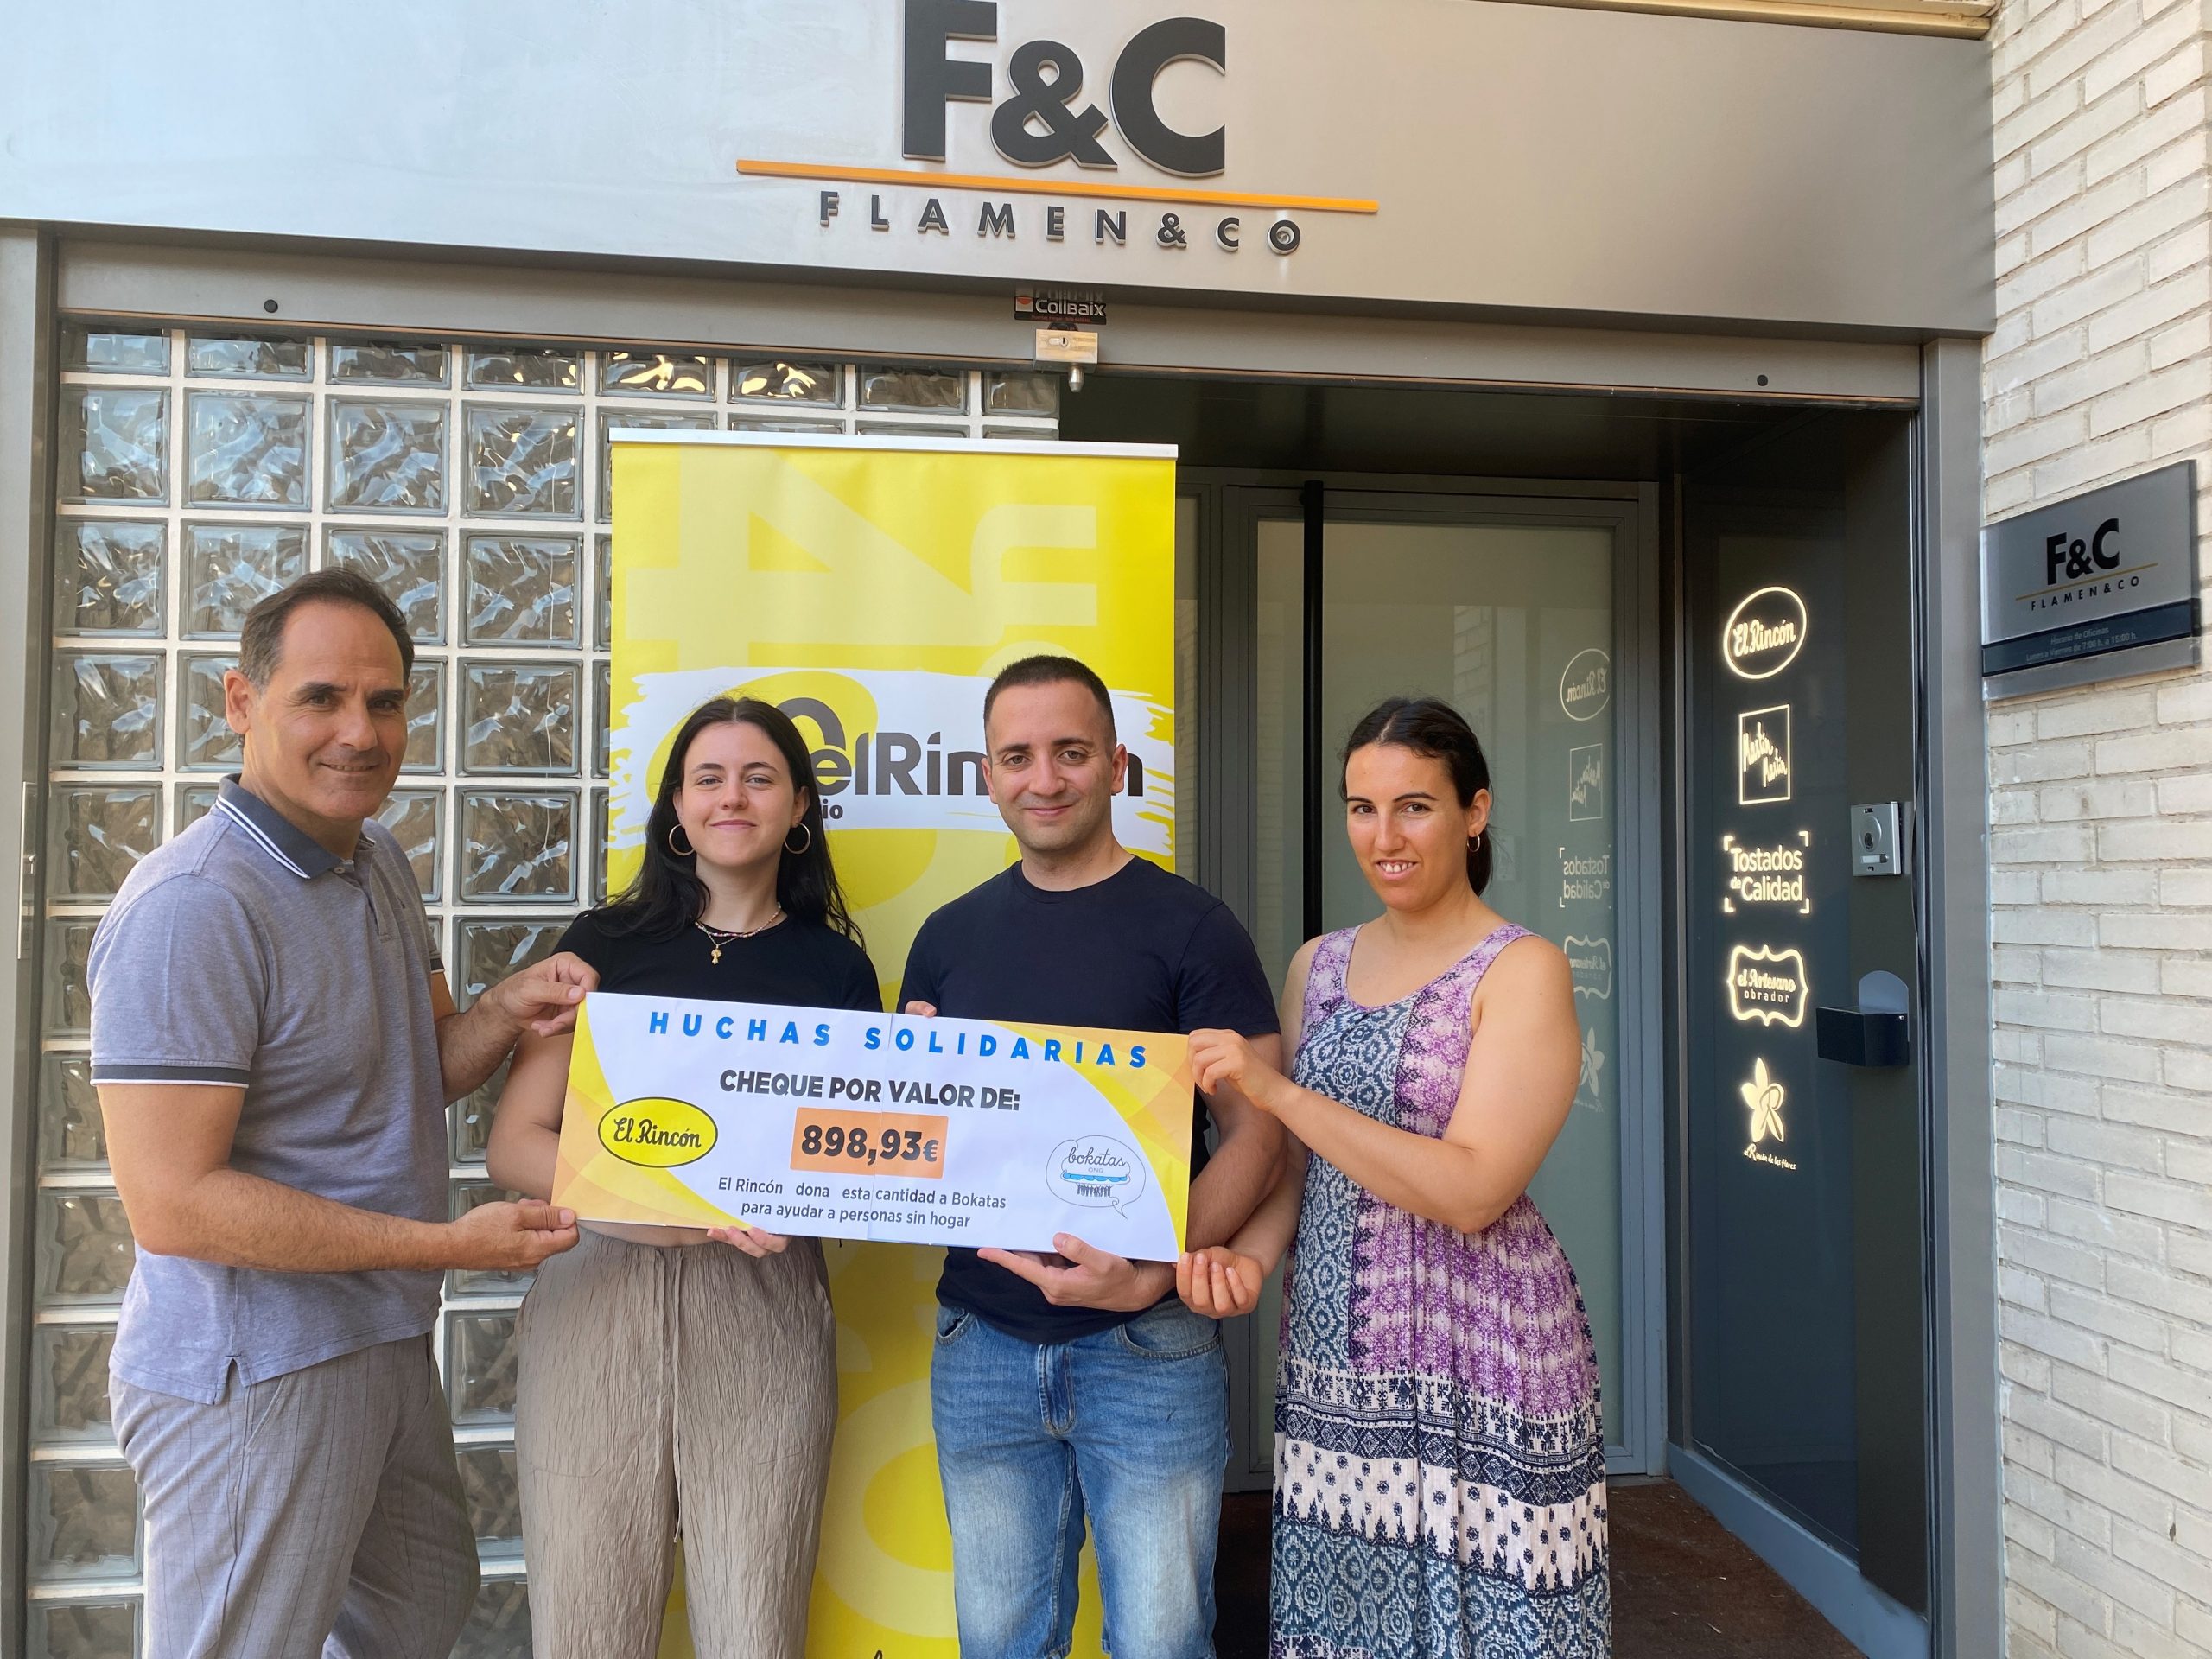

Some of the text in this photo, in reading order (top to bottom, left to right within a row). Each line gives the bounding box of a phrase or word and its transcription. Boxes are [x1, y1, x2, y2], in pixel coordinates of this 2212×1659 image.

[902, 0, 1225, 177] F&C
[2046, 518, 2120, 585] F&C
[2031, 576, 2140, 611] FLAMEN&CO
[1733, 619, 1796, 657] El Rincón
[1731, 843, 1802, 872] Tostados
[1742, 874, 1802, 901] Calidad
[1738, 969, 1748, 987] el
[1745, 989, 1790, 1003] obrador
[650, 1011, 1147, 1069] HUCHAS SOLIDARIAS
[719, 1069, 1020, 1111] CHEQUE POR VALOR DE:
[613, 1117, 702, 1148] El Rincón
[800, 1124, 939, 1166] 898,93€
[1068, 1147, 1126, 1167] bokatas
[718, 1177, 1007, 1209] El Rincón dona esta cantidad a Bokatas
[741, 1200, 971, 1231] para ayudar a personas sin hogar
